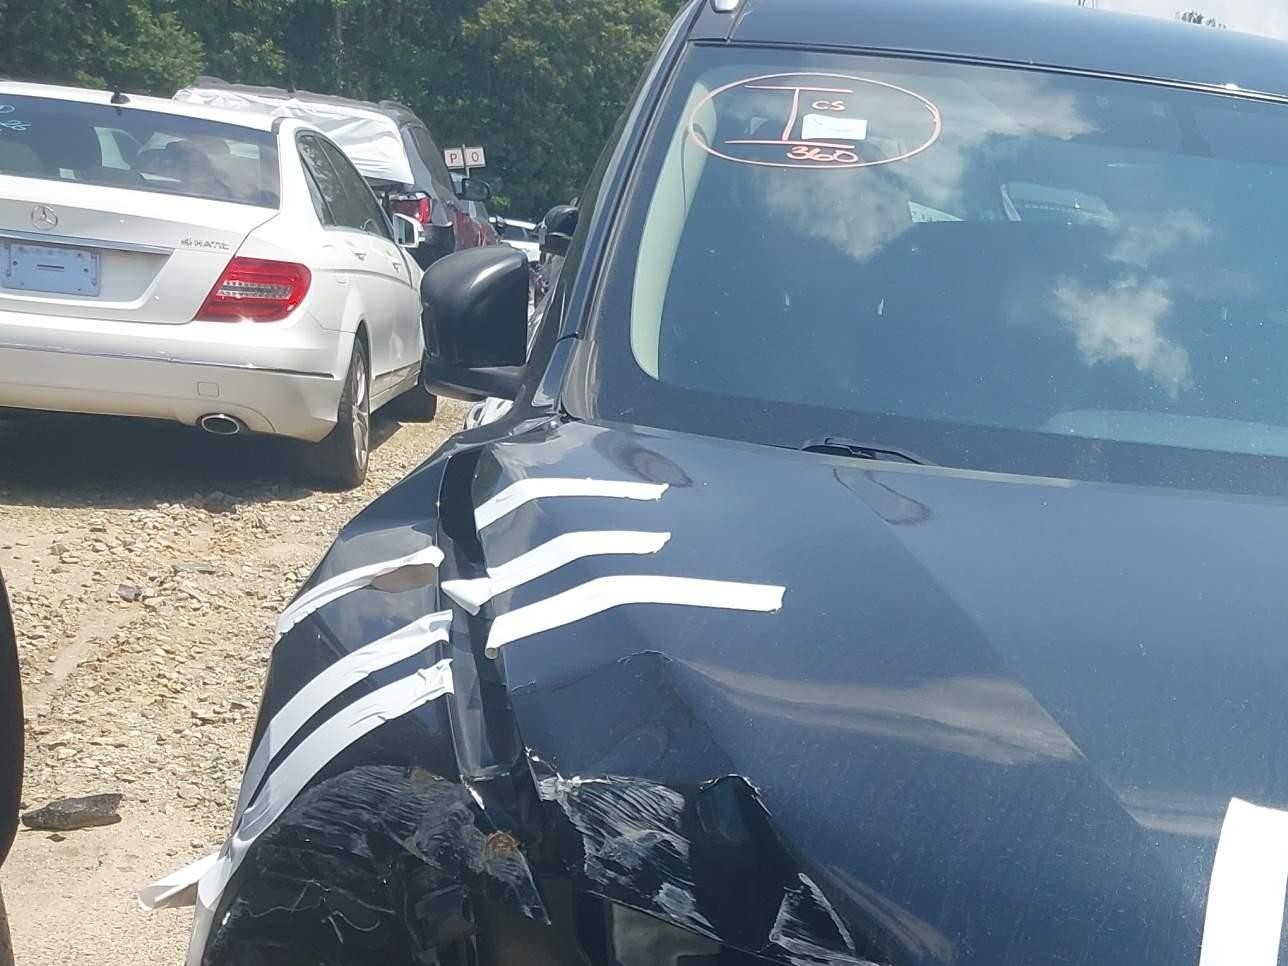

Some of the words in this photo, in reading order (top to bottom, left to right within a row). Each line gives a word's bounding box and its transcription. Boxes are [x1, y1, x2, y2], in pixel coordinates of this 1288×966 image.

[811, 100, 846, 112] CS
[449, 153, 458, 164] P
[786, 145, 859, 163] 360
